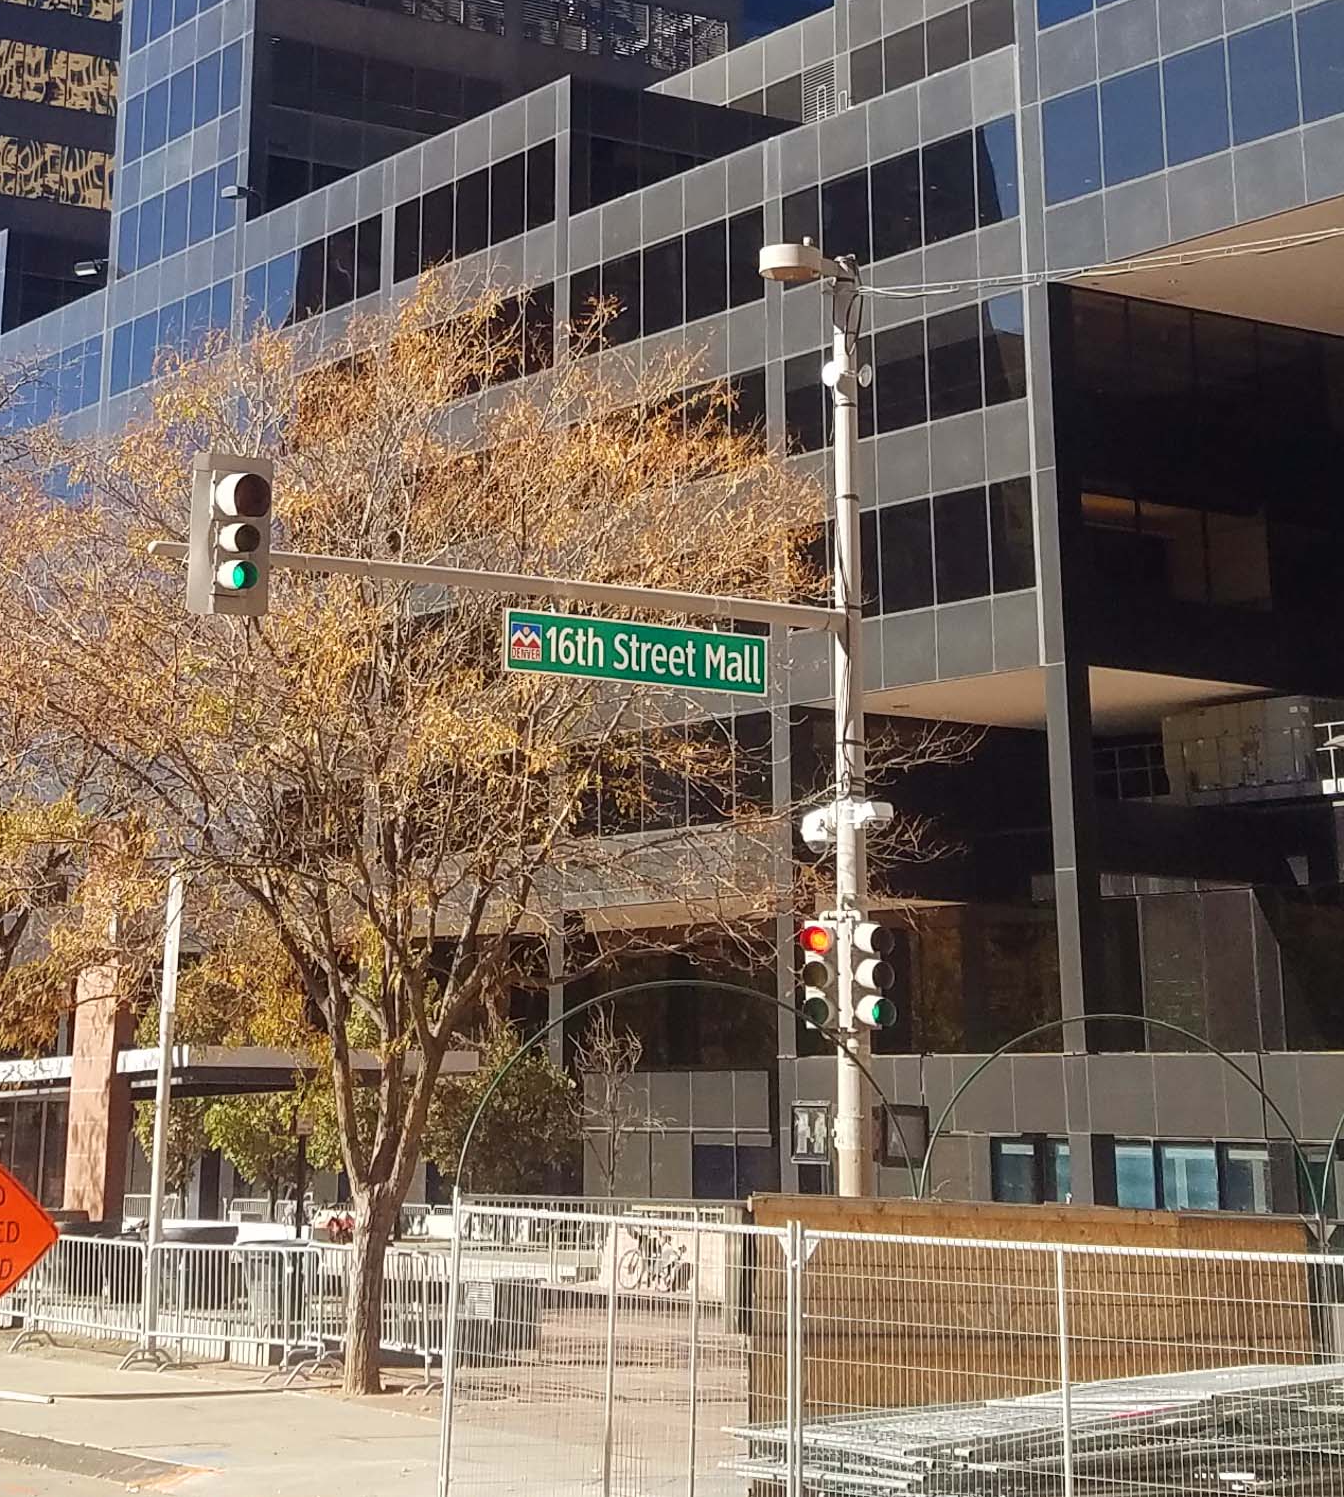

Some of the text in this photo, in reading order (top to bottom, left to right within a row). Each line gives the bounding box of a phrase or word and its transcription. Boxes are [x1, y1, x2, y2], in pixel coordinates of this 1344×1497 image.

[511, 646, 541, 660] DENVER
[545, 626, 761, 685] 16th Street Mall
